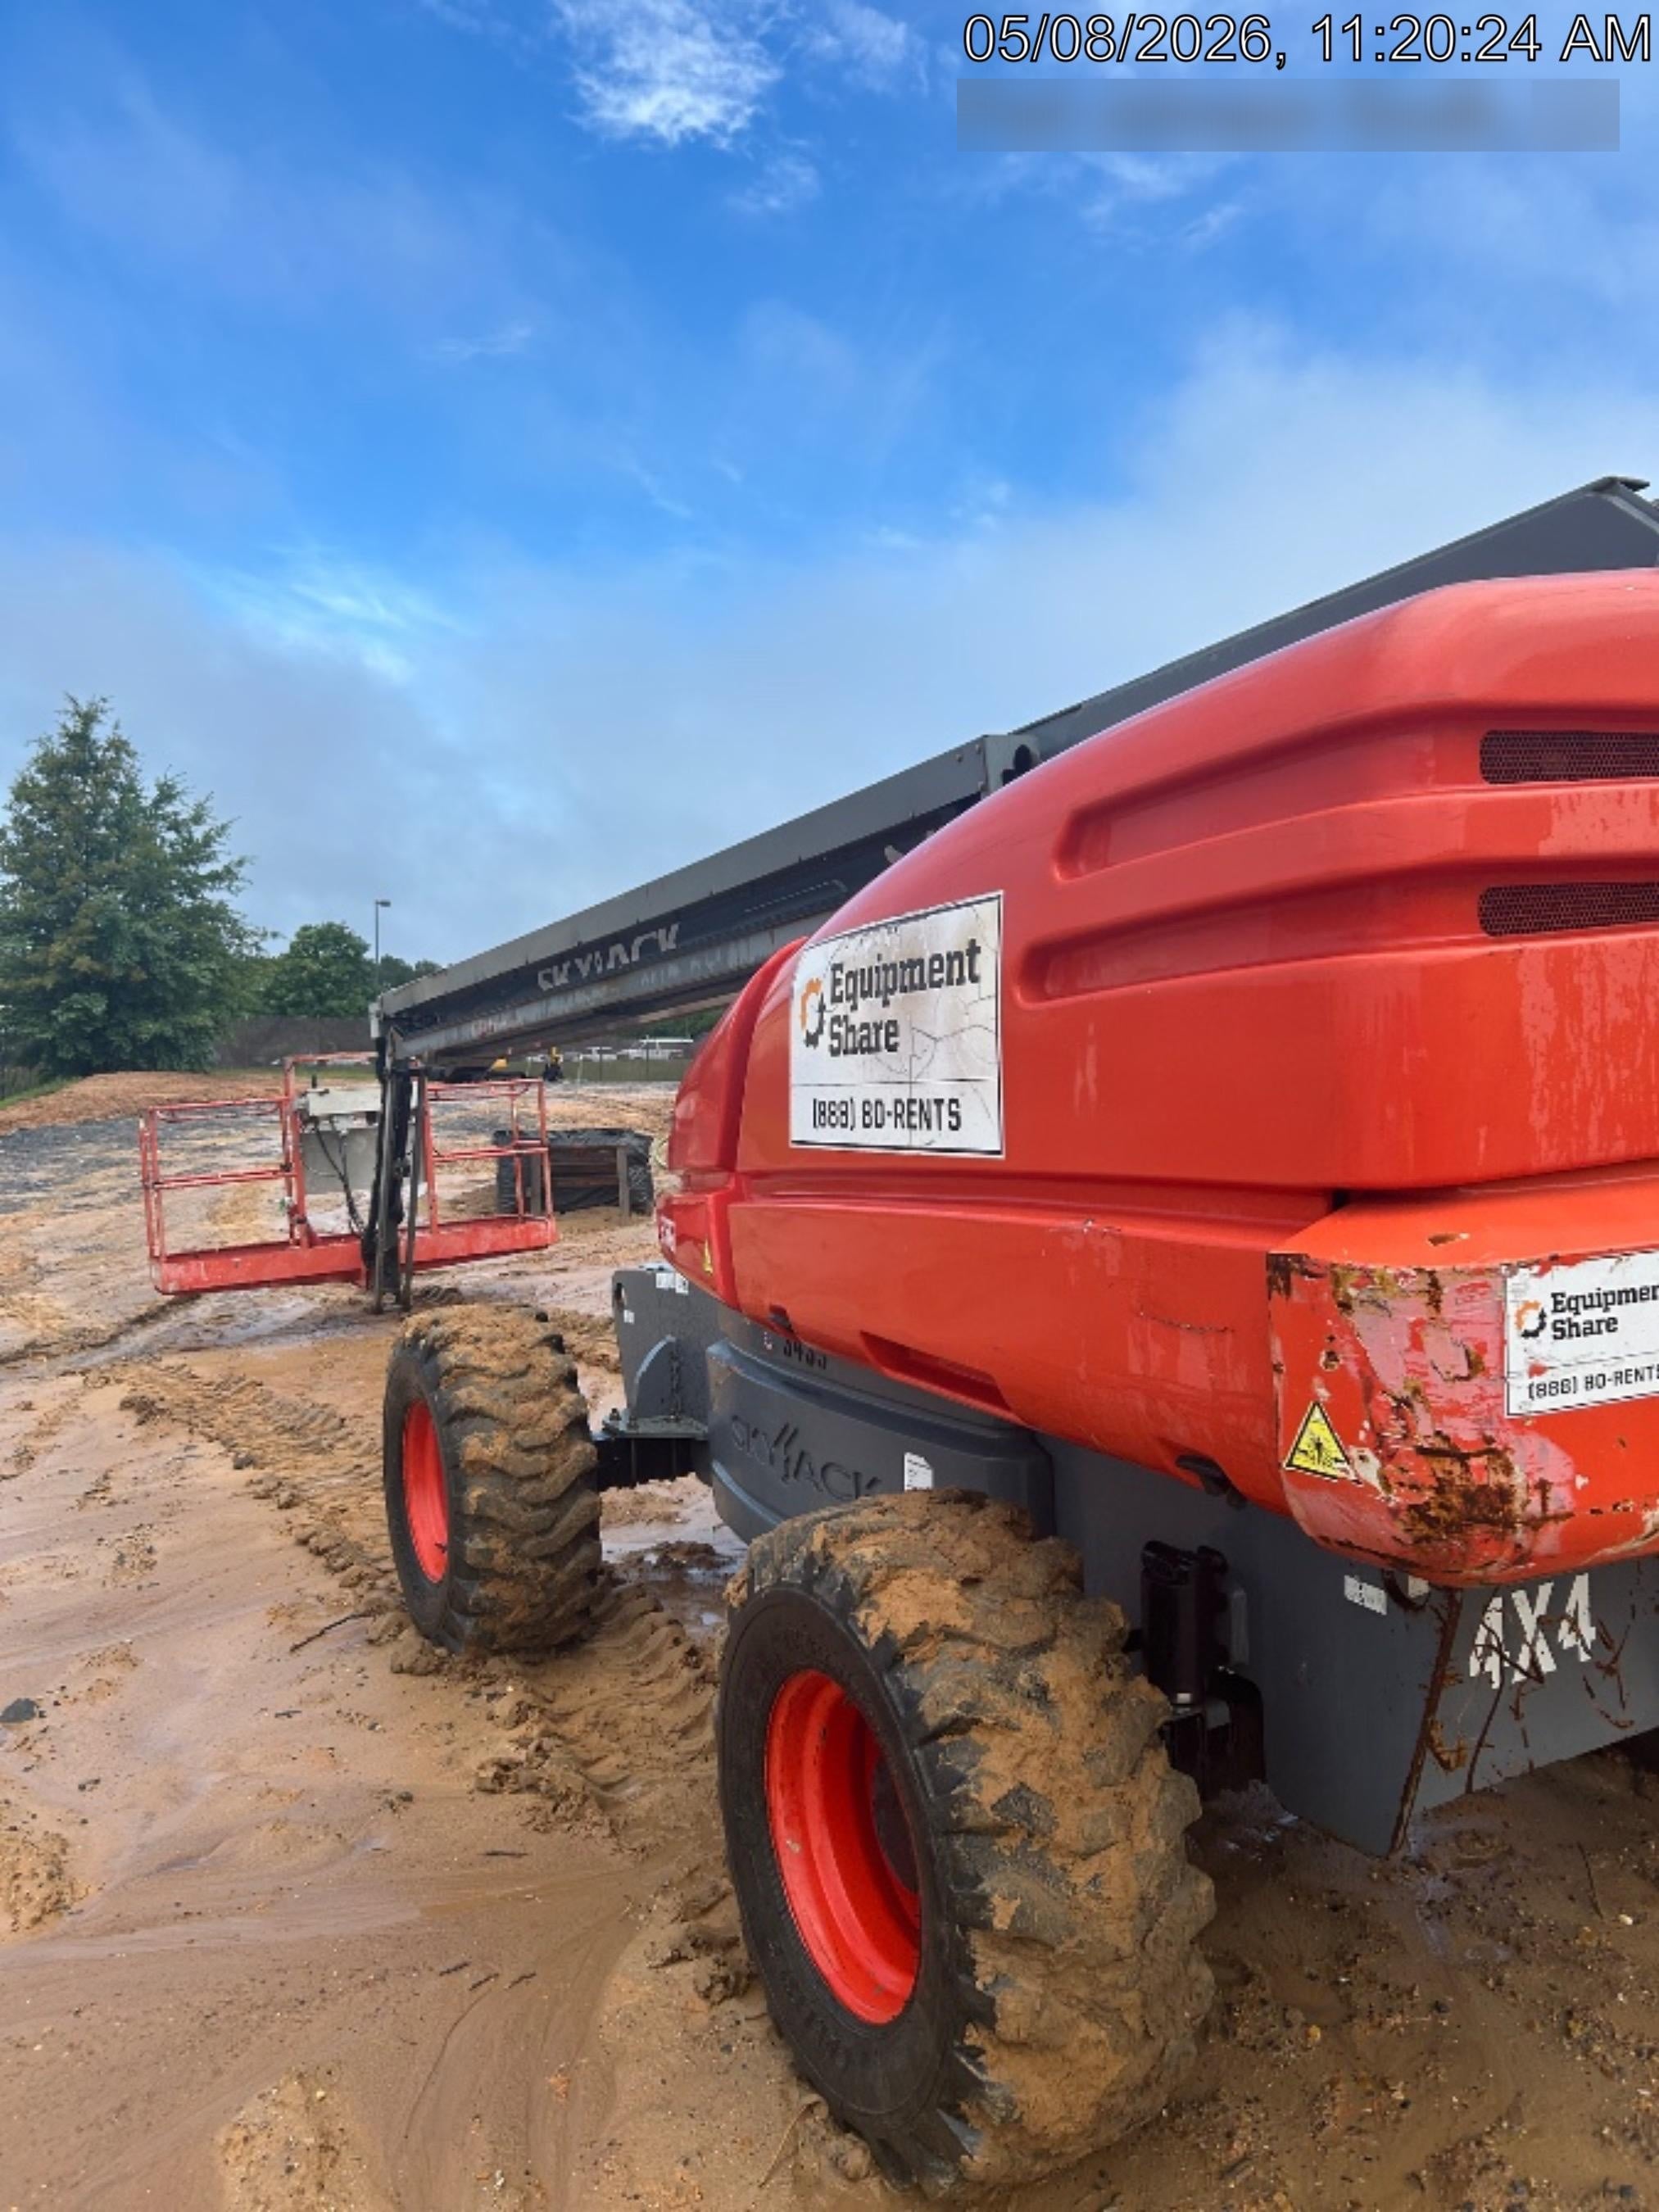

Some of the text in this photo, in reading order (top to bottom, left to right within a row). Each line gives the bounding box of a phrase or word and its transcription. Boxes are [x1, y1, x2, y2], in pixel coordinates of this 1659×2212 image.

[829, 938, 981, 1010] Equipment
[828, 1015, 900, 1057] Share
[1552, 1316, 1619, 1341] Share
